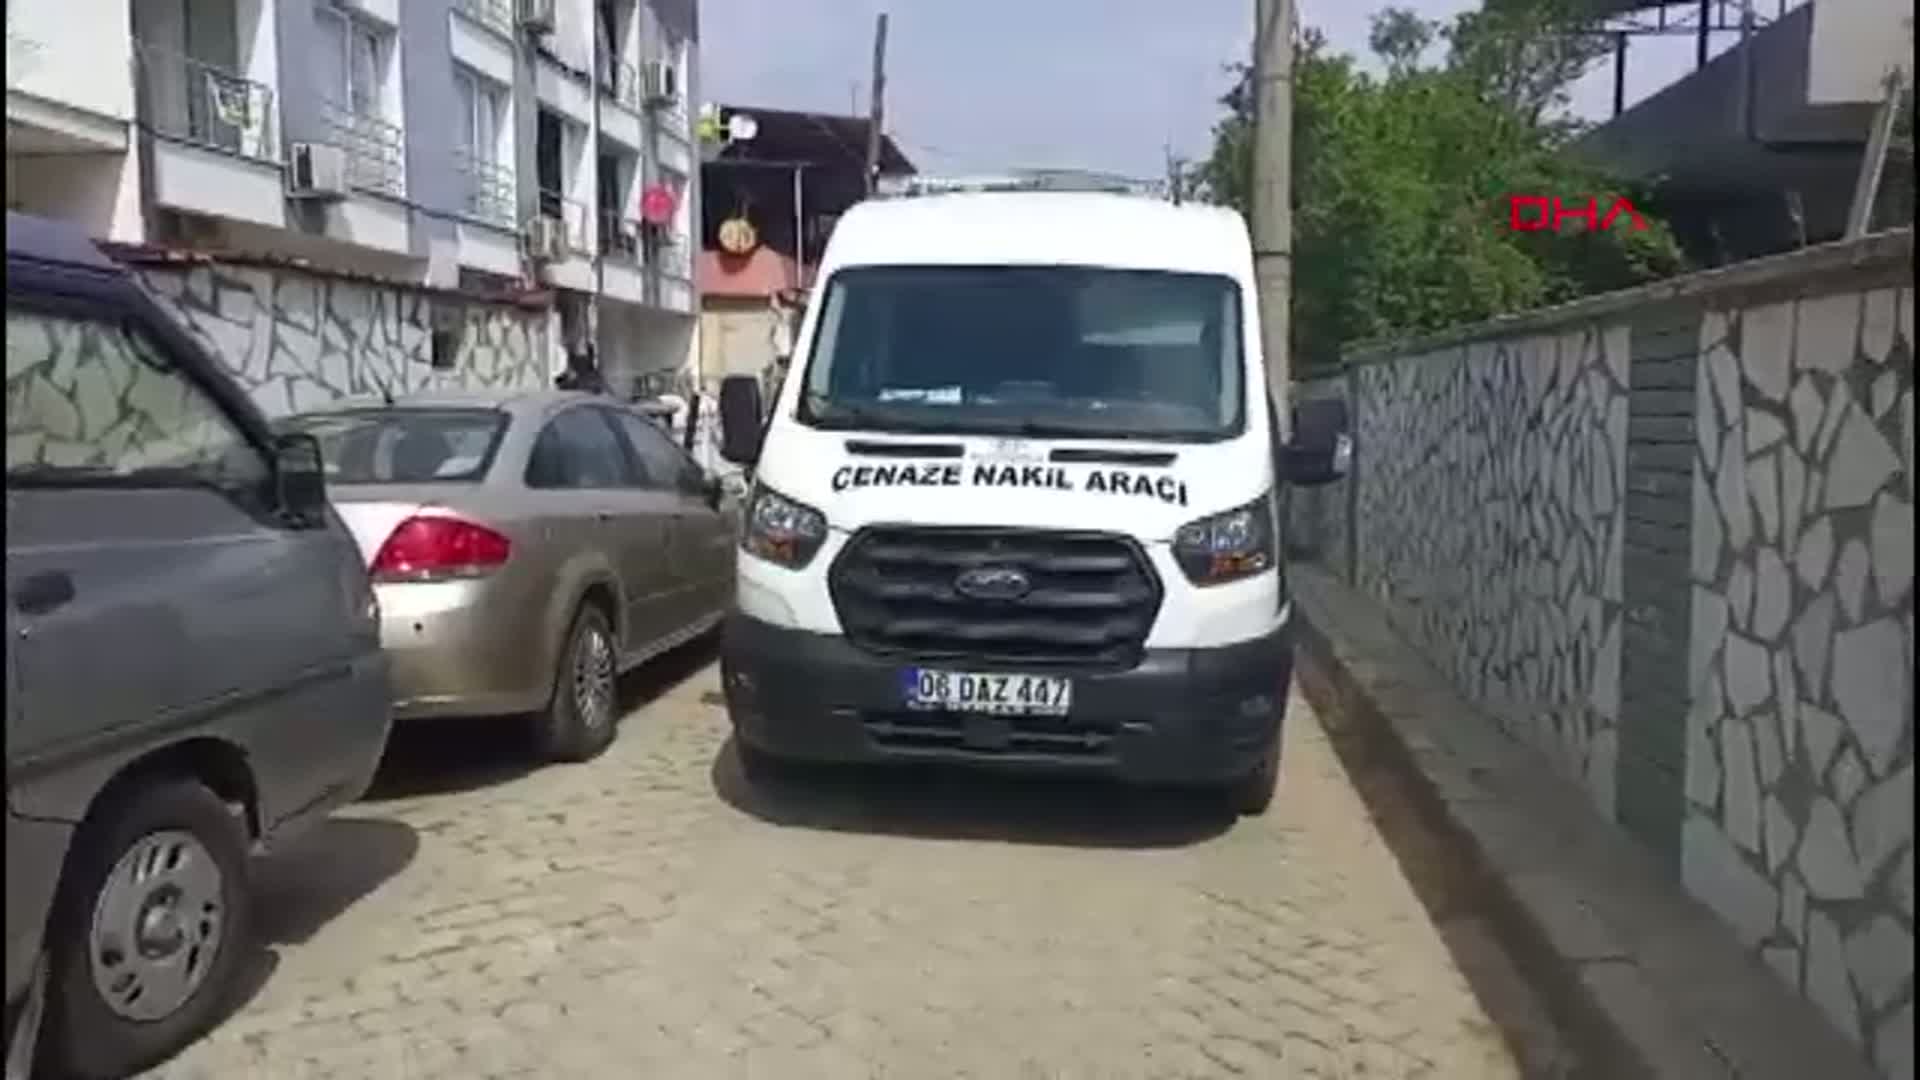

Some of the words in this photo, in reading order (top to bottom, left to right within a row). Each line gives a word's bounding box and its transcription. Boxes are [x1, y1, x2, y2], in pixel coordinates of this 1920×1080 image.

[831, 464, 962, 493] CENAZE
[1084, 469, 1189, 508] ARACI
[959, 676, 1009, 702] DAZ
